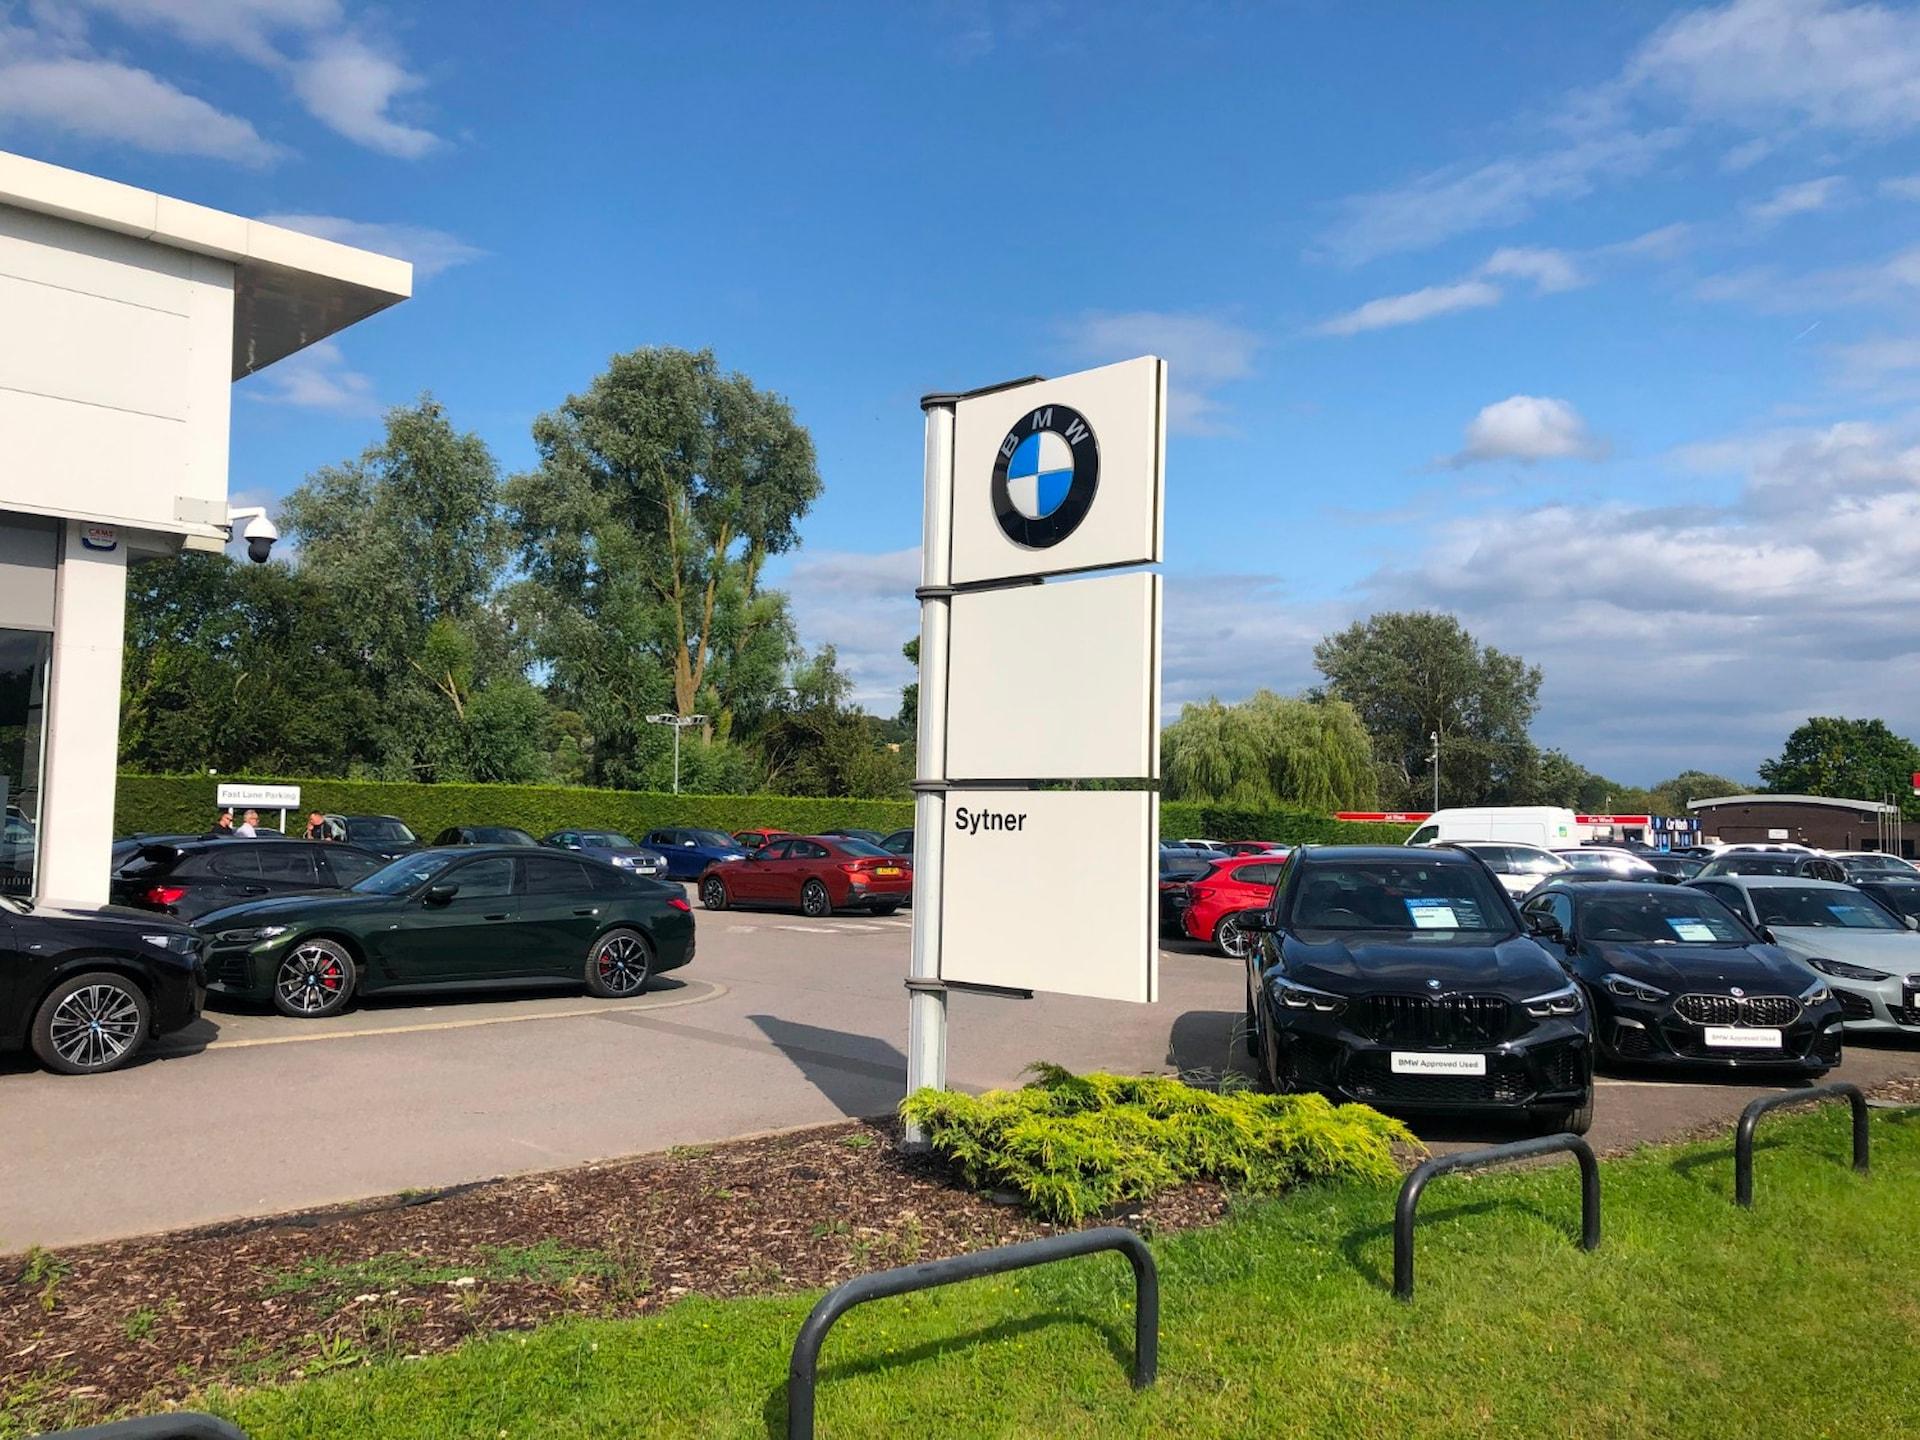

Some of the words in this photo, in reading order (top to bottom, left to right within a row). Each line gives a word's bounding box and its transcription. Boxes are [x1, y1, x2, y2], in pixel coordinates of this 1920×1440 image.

[1001, 407, 1089, 458] BMW
[222, 790, 241, 798] Fast
[243, 791, 263, 799] Lane
[265, 791, 297, 801] Parking
[955, 807, 1027, 835] Sytner
[1420, 1060, 1458, 1068] Approved
